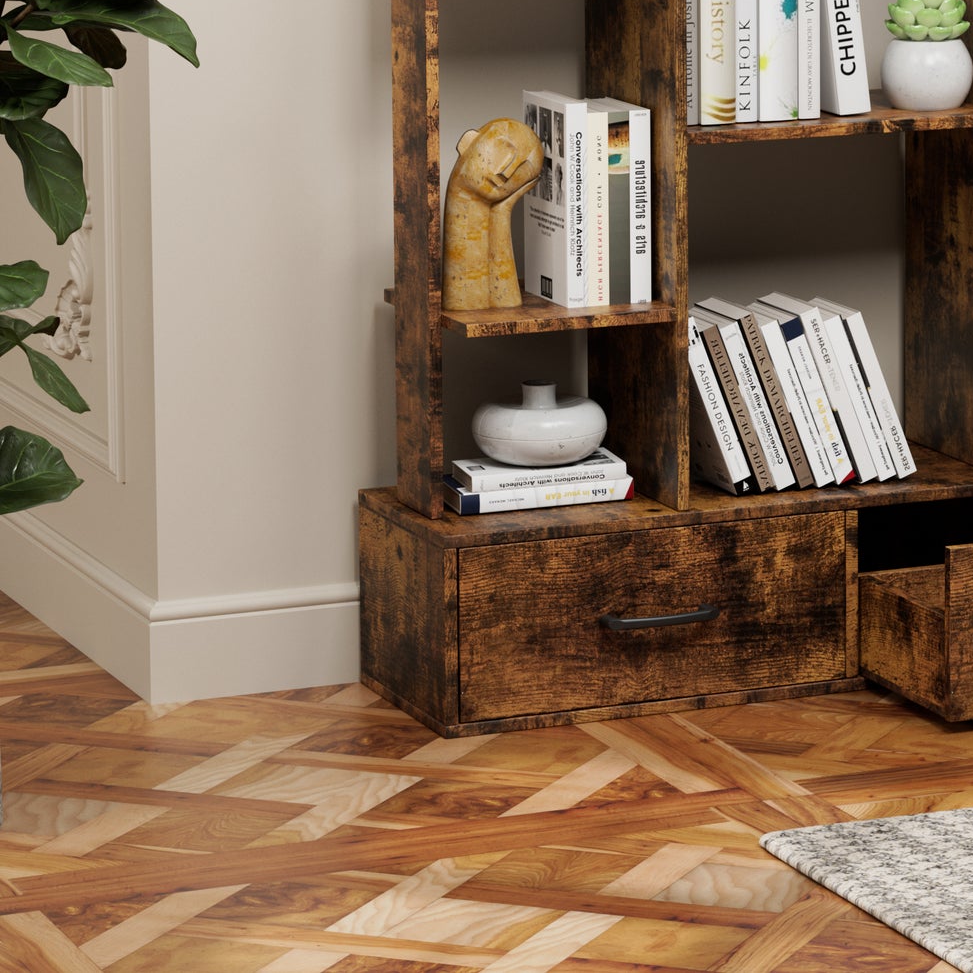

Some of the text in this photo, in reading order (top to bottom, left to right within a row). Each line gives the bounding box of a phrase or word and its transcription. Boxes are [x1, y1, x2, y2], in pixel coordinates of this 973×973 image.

[739, 19, 751, 111] KINFOLK
[576, 205, 584, 225] with
[576, 228, 584, 277] Architects
[696, 363, 735, 452] FASHION DESIGN
[743, 314, 768, 367] PATRICK
[762, 369, 804, 467] DEMARCHELIER
[498, 480, 535, 489] Architects
[554, 473, 606, 484] Conversations
[591, 488, 607, 498] fish
